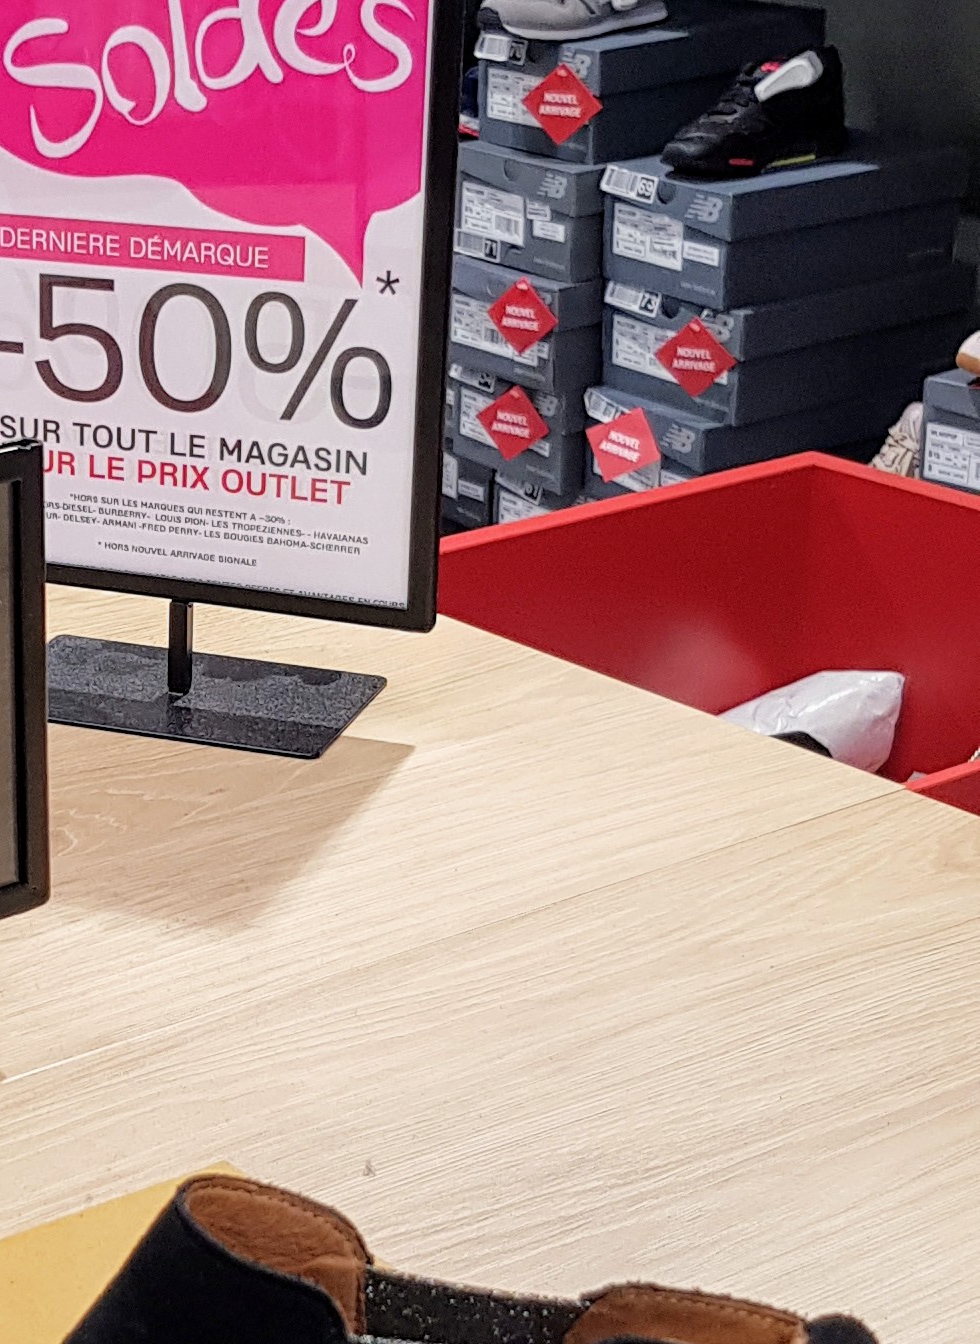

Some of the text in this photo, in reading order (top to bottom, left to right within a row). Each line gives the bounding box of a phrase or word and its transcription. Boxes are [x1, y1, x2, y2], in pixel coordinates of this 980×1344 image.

[0, 226, 270, 269] DERNIERE DÉMARQUE
[677, 346, 712, 361] NOUVEL
[673, 359, 716, 373] ARRIVAGE
[0, 415, 368, 476] SUR TOUT LE MAGASIN
[608, 430, 641, 450] NOUVEL
[599, 441, 641, 464] ARRIVAGE
[43, 450, 352, 506] UR LE PRIX OUTLET
[101, 496, 120, 506] SUR
[122, 498, 138, 507] LES
[140, 500, 185, 513] MARQUES
[187, 505, 203, 515] QUI
[206, 507, 248, 520] RESTENT
[102, 518, 137, 530] ARMANI
[204, 529, 221, 539] LES
[223, 532, 265, 544] BOUGIES
[155, 513, 182, 524] LOUIS
[211, 519, 229, 529] LES
[313, 530, 369, 545] HAVAIANAS
[104, 541, 130, 552] HORS
[131, 545, 168, 557] NOUVEL
[170, 549, 216, 562] ARRIVAGE
